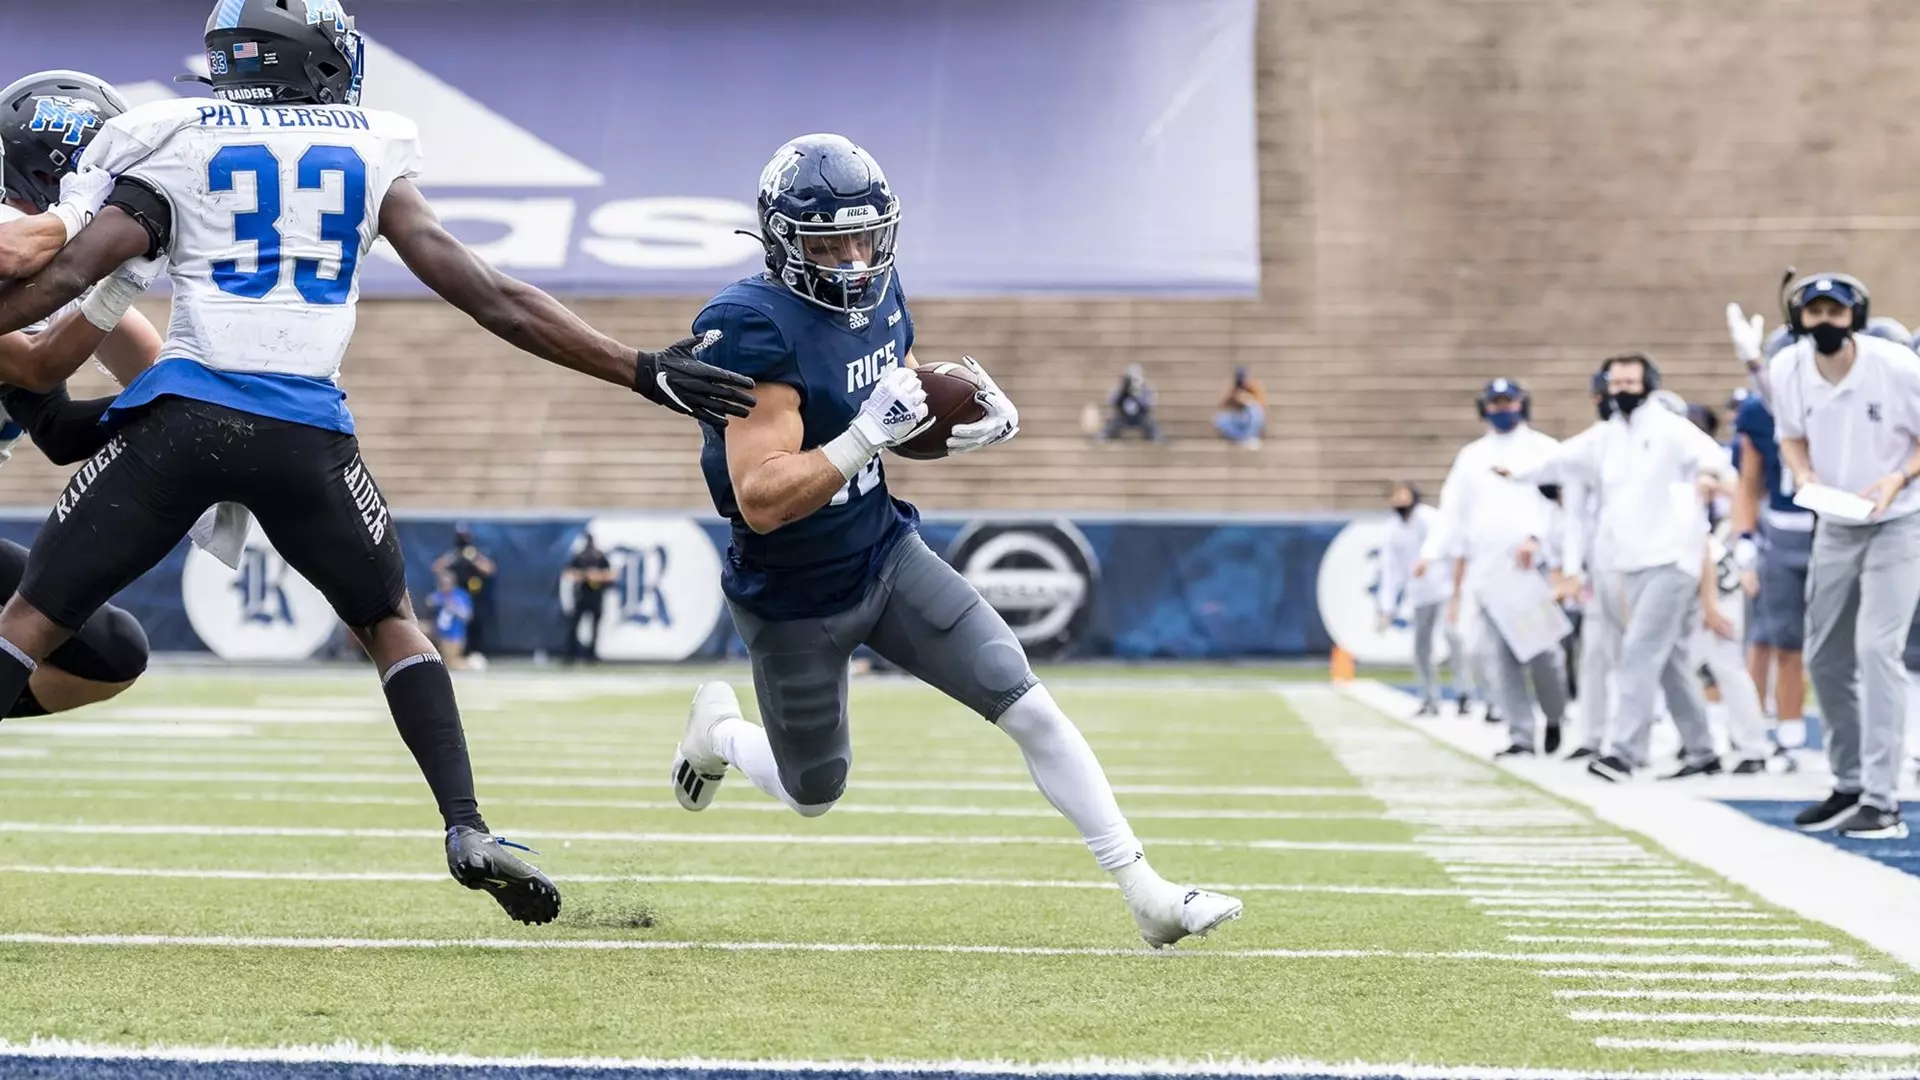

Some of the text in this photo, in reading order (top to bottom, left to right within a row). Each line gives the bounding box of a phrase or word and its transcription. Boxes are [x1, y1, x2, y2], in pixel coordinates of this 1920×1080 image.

[227, 87, 273, 100] RAIDERS
[29, 97, 97, 145] MT
[197, 104, 370, 130] PATTERSON
[847, 207, 869, 217] RICE
[206, 142, 370, 307] 33
[883, 412, 917, 426] adidas
